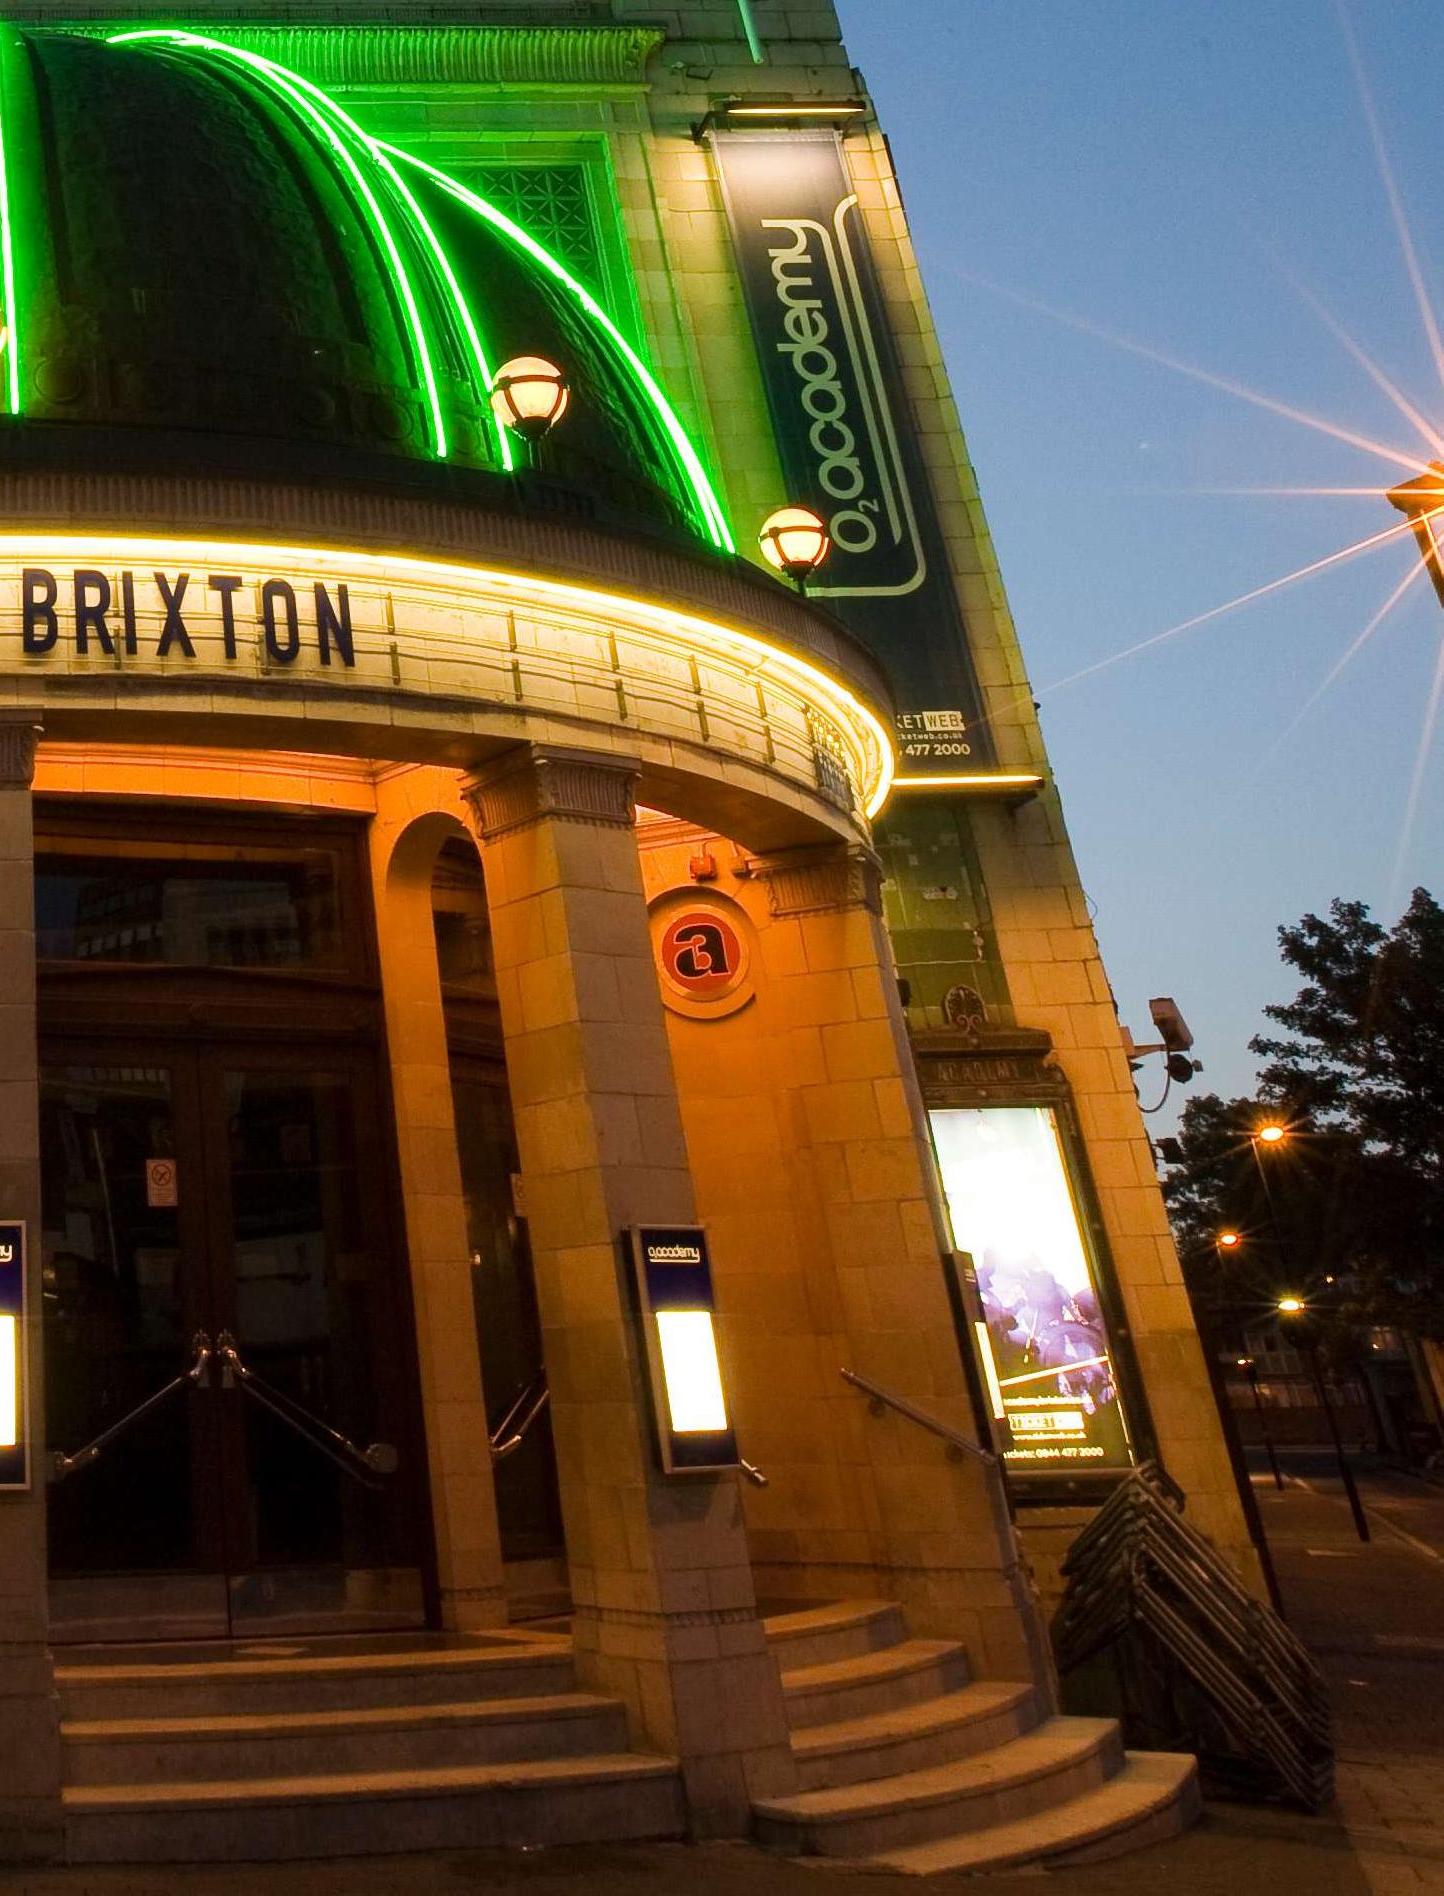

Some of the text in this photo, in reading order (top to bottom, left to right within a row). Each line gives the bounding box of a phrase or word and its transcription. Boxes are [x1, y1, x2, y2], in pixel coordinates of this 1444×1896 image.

[22, 568, 356, 668] BRIXTON
[905, 744, 971, 755] 477 2000
